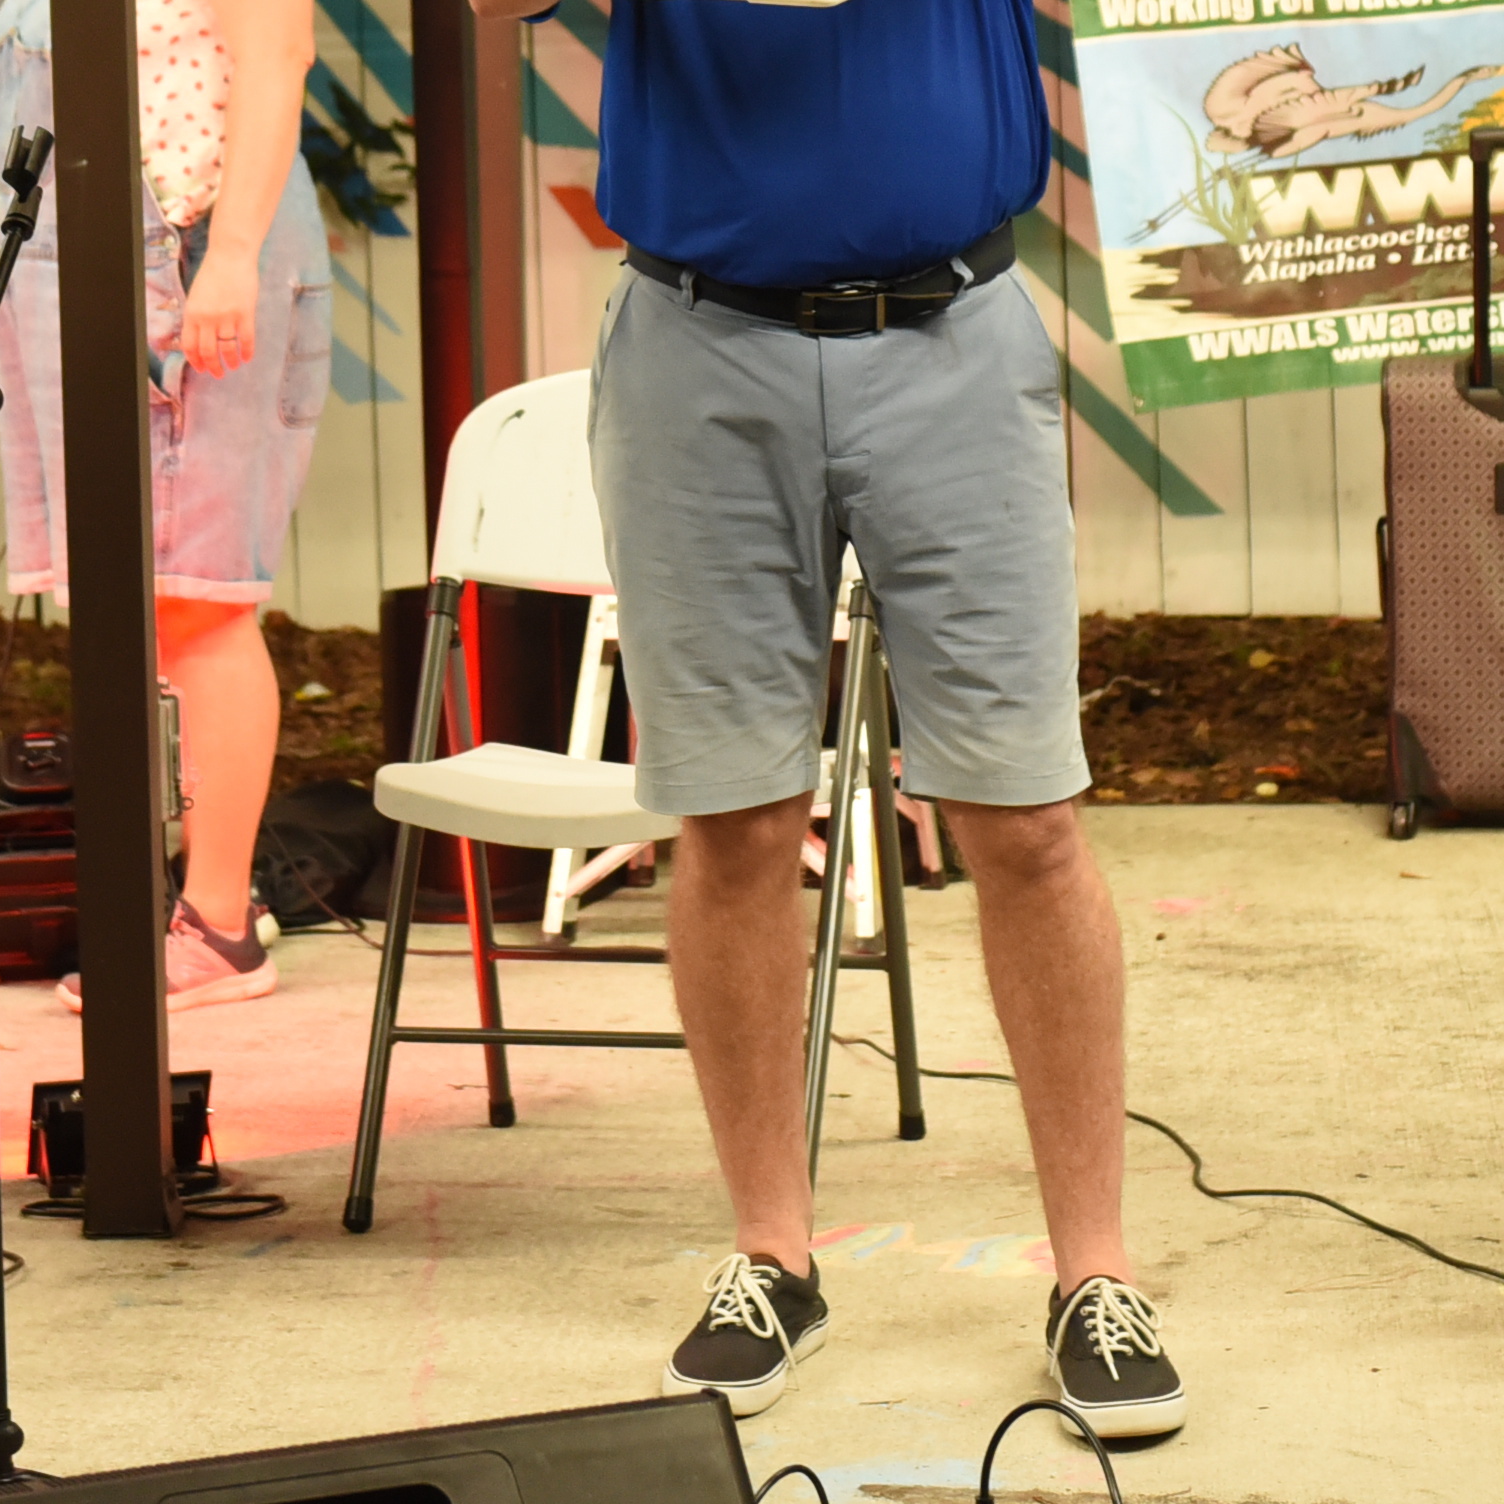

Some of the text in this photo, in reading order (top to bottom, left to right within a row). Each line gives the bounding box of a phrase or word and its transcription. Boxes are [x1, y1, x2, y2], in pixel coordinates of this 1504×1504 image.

[1238, 222, 1471, 265] Withlacoochee
[1241, 252, 1377, 285] Alapaha
[1187, 318, 1340, 362] WWALS
